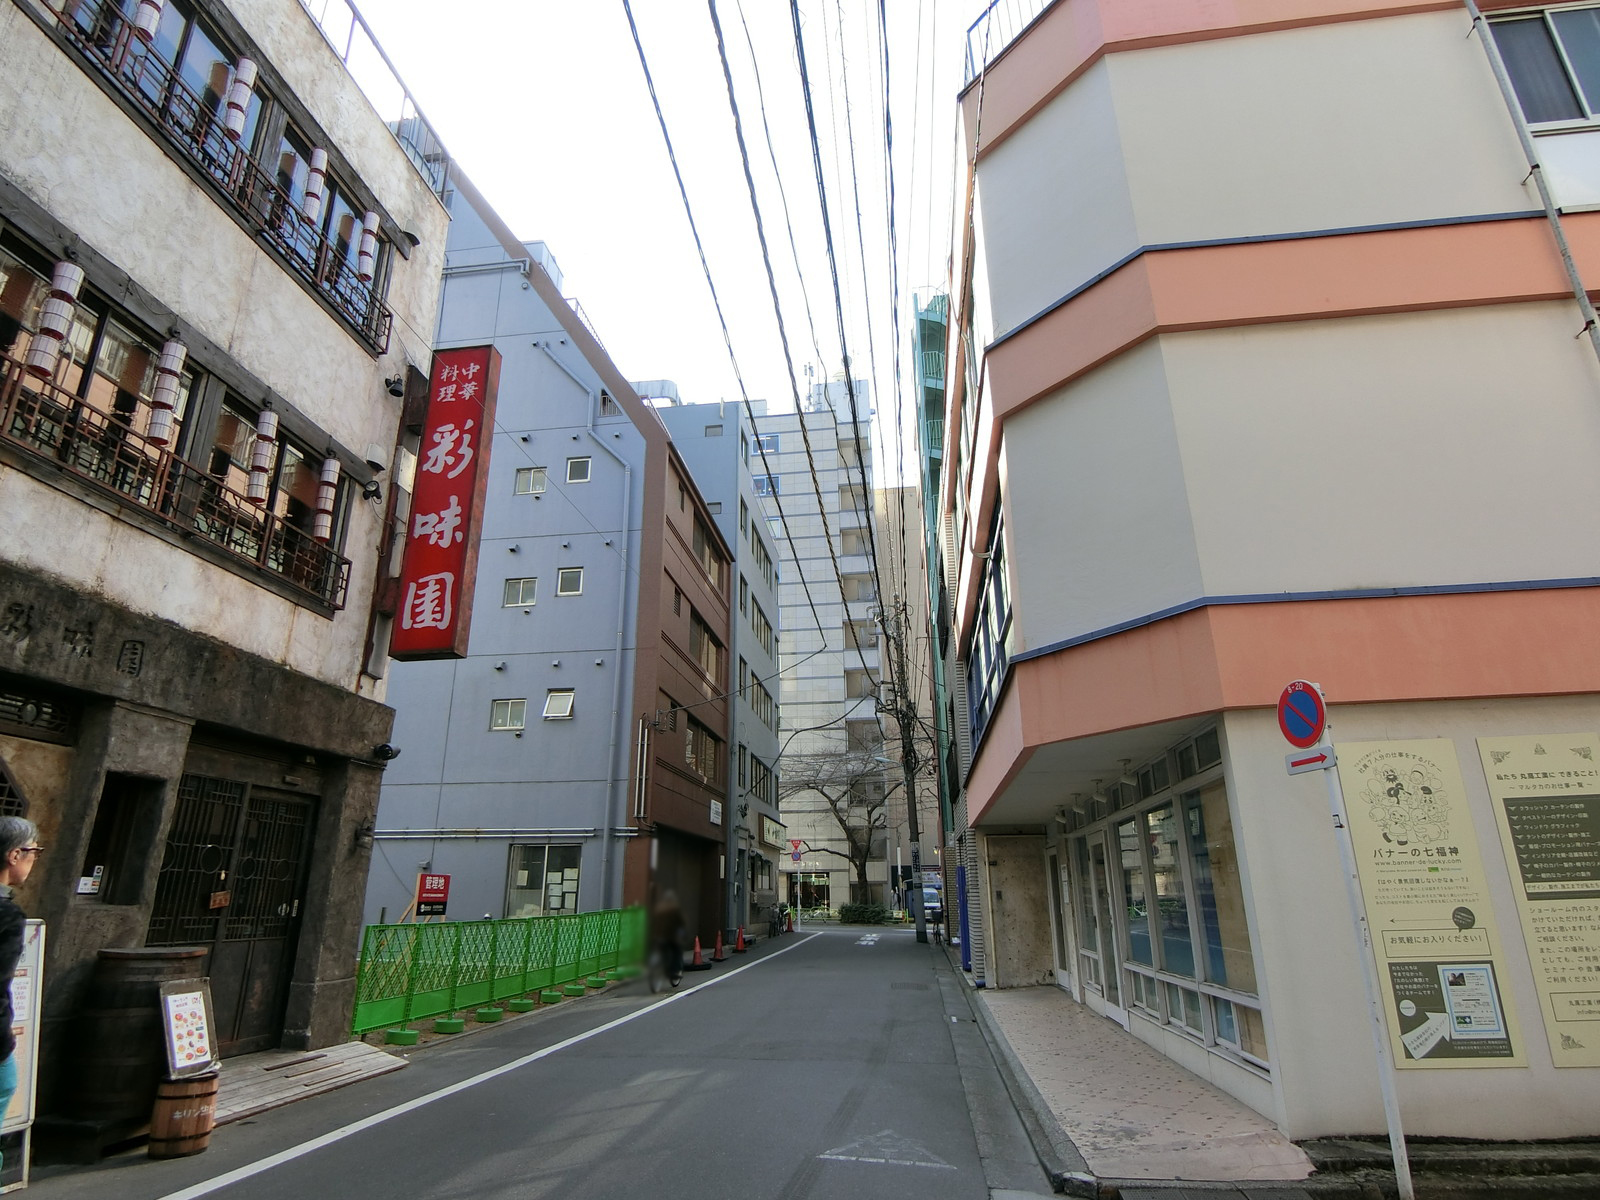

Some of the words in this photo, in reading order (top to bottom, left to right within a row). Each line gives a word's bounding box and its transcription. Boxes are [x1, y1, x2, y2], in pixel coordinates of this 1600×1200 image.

[436, 364, 458, 403] 料理
[458, 362, 480, 401] 中華
[401, 418, 474, 631] 彩味園
[1287, 682, 1303, 694] 8-20
[1373, 846, 1460, 858] バナーの七福神
